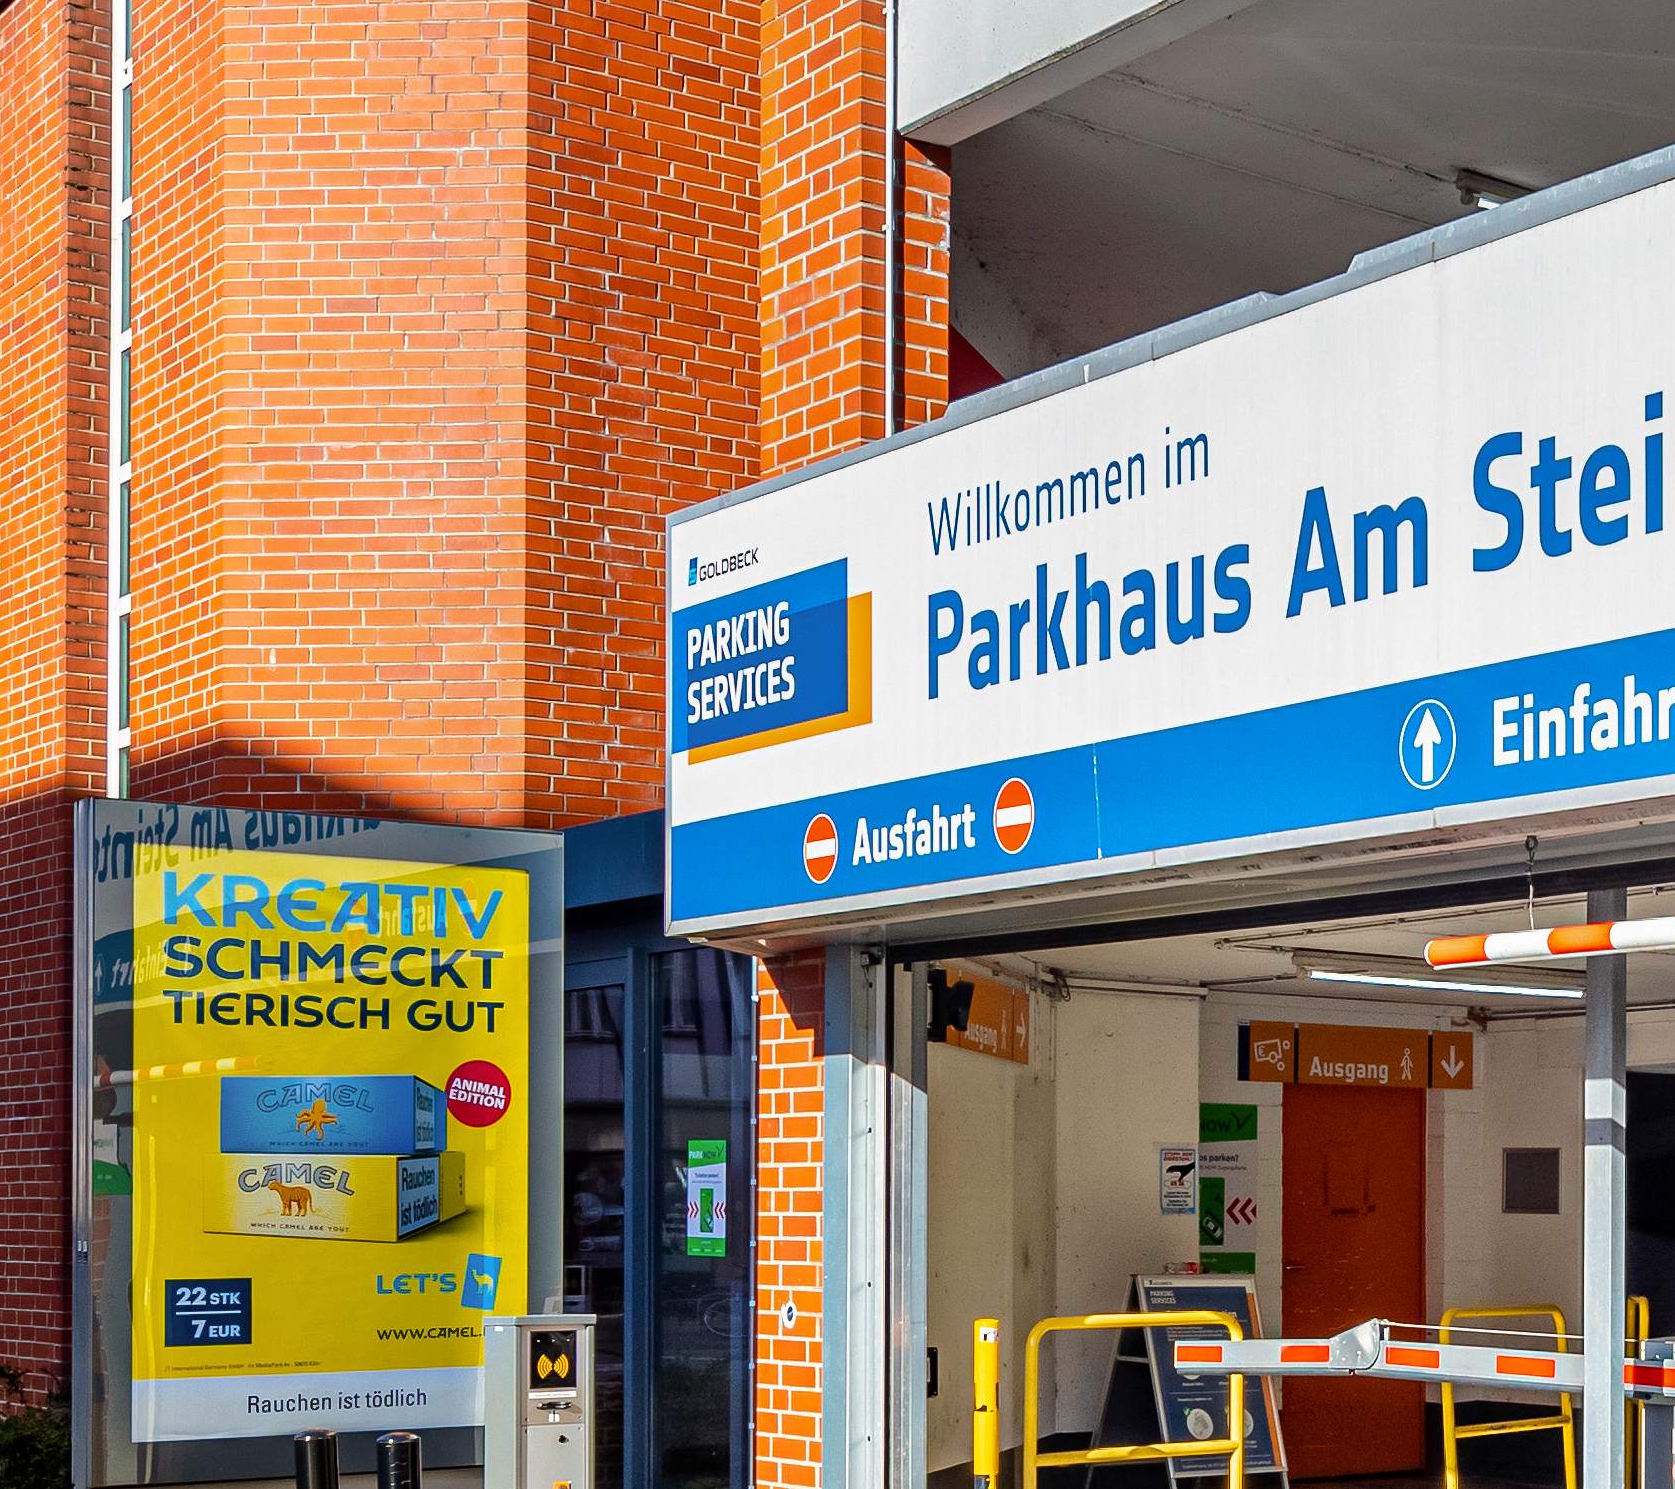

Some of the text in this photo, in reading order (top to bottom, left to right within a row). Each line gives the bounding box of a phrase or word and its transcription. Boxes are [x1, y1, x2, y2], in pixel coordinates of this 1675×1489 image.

[927, 426, 1210, 556] Willkommen im
[699, 547, 759, 583] GOLDBECK
[927, 542, 1251, 700] Parkhaus
[1286, 485, 1429, 619] Am
[686, 601, 790, 672] PARKING
[686, 656, 796, 725] SERVICES
[852, 803, 977, 867] Ausfahrt
[162, 871, 504, 940] KREATIV
[163, 935, 505, 990] SCHMECKT
[162, 990, 505, 1033] TIERISCH GUT
[1309, 1056, 1389, 1084] Ausgang
[256, 1082, 375, 1113] CAMEL
[448, 1088, 506, 1109] EDITION
[451, 1077, 506, 1098] ANIMAL
[269, 1140, 293, 1148] WHICH
[298, 1140, 324, 1148] CAMEL
[328, 1140, 345, 1148] ARE
[1208, 1154, 1239, 1163] parken?
[237, 1163, 355, 1196] CAMEL
[401, 1165, 436, 1192] Rauchen
[400, 1195, 438, 1225] ist tödlich
[327, 1224, 350, 1232] YOU?
[175, 1286, 241, 1307] 22 STK
[376, 1272, 457, 1296] LET'S
[191, 1319, 241, 1340] 7 EUR
[376, 1326, 484, 1342] WWW.CAMEL.
[248, 1388, 427, 1414] Rauchen ist tödlich
